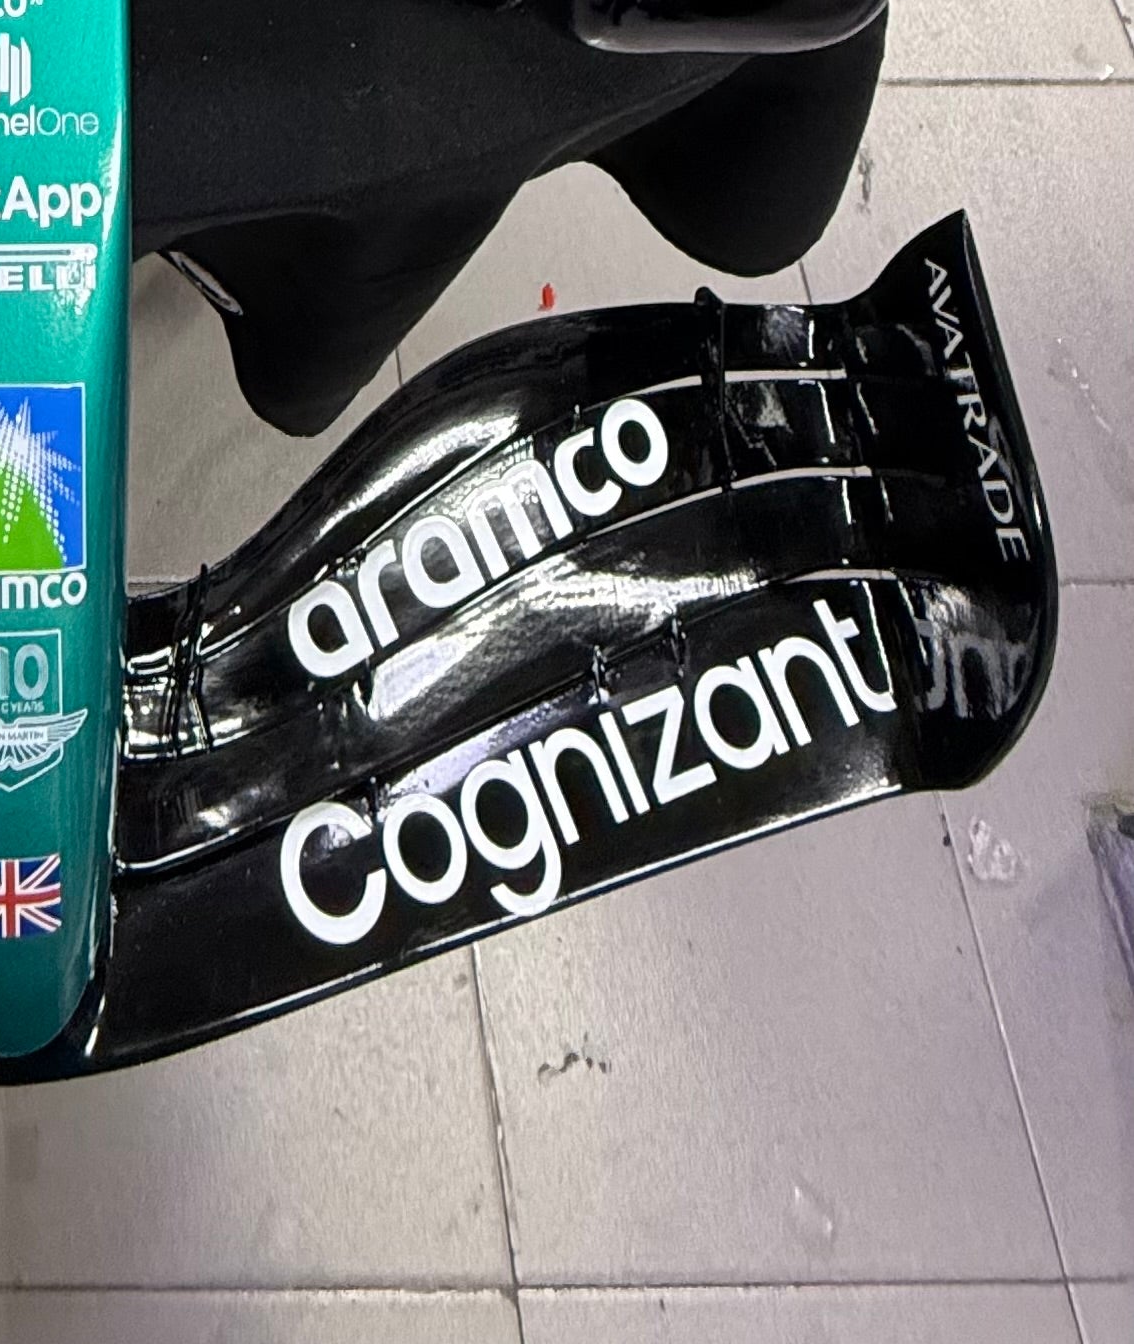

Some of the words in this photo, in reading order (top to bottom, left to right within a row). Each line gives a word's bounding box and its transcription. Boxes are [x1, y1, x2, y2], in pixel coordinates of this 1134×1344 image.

[286, 398, 670, 680] aramco
[923, 257, 1030, 564] AVATRADE
[280, 598, 897, 946] Cognizant
